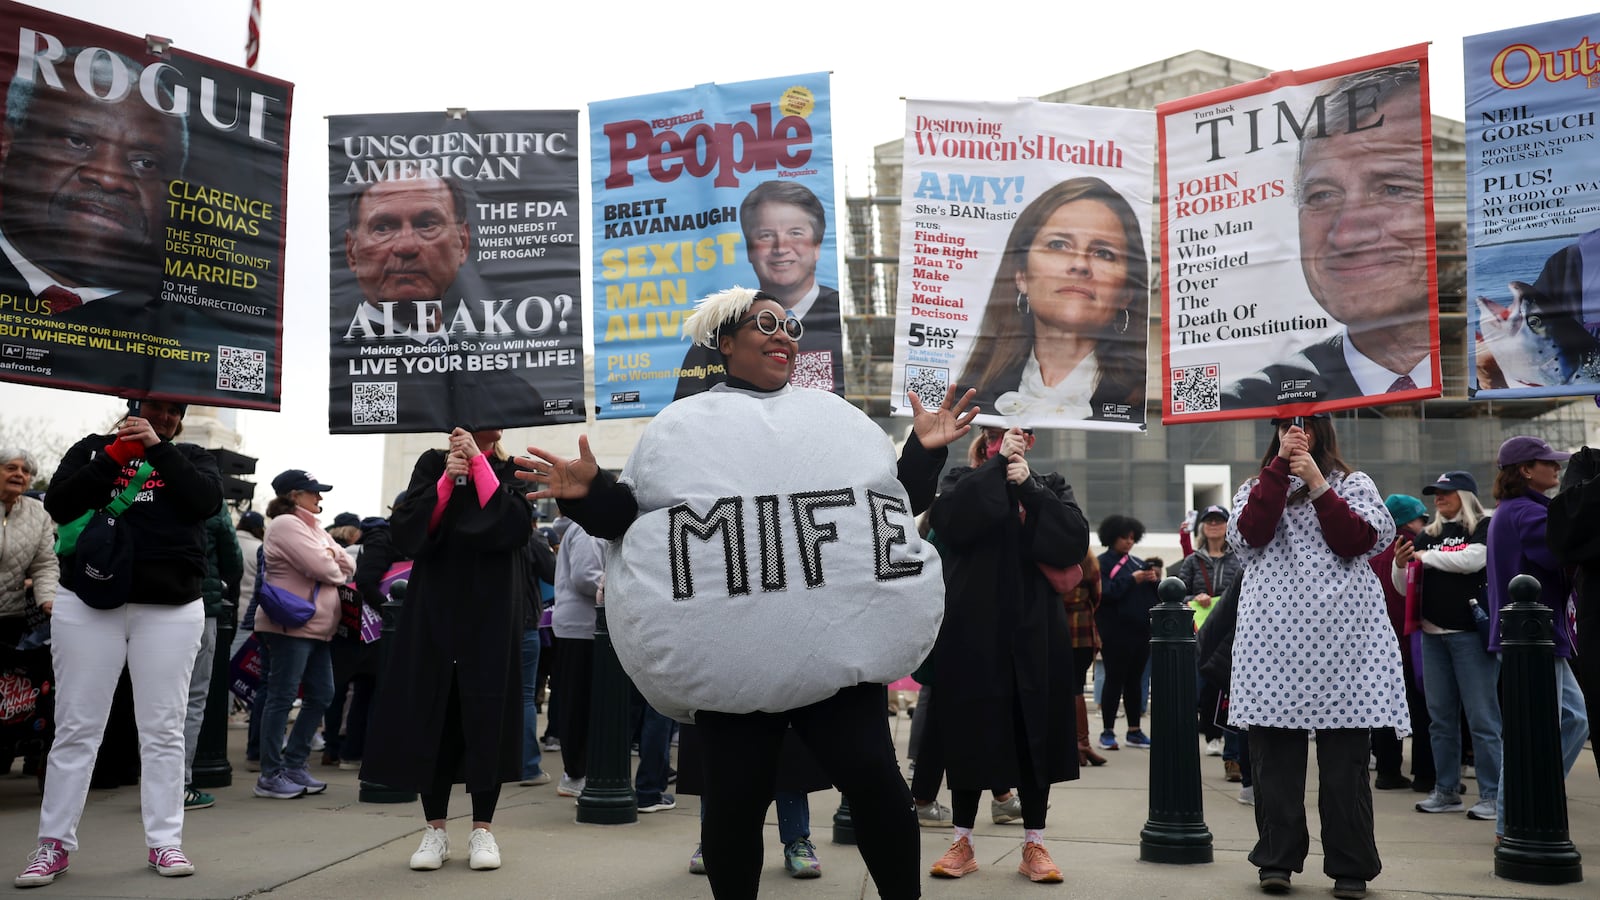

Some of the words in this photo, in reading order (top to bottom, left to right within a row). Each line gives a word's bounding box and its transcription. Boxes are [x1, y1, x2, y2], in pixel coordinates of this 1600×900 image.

[17, 27, 280, 145] ROGUE
[651, 109, 704, 131] regnant
[1194, 111, 1214, 120] Turn
[1215, 104, 1235, 115] back
[1195, 83, 1385, 163] TIME
[1481, 105, 1534, 125] NEIL
[916, 115, 1002, 140] Destroying
[1481, 112, 1595, 143] GORSUCH
[343, 132, 567, 159] UNSCIENTIFIC
[603, 102, 813, 190] People
[1482, 143, 1530, 158] PIONEER
[1534, 141, 1546, 149] IN
[1548, 133, 1595, 146] STOLEN
[1481, 152, 1526, 167] SCOTUS
[1528, 147, 1564, 159] SEATS
[343, 155, 521, 185] AMERICAN
[777, 168, 818, 178] Magazine
[1483, 168, 1552, 193] PLUS!
[913, 171, 1025, 205] AMY!
[1174, 171, 1239, 201] JOHN
[1483, 195, 1504, 207] MY
[1508, 189, 1548, 203] BODY
[1551, 185, 1572, 196] OF
[168, 180, 272, 220] CLARENCE
[604, 198, 667, 221] BRETT
[1175, 179, 1285, 219] ROBERTS
[1483, 207, 1504, 219] MY
[1508, 197, 1565, 215] CHOICE
[167, 200, 259, 236] THOMAS
[477, 203, 518, 220] THE
[524, 201, 568, 218] FDA
[915, 204, 946, 216] She's
[949, 203, 1017, 221] BANtastic
[1483, 219, 1499, 227] The
[1501, 215, 1538, 226] Supreme
[1540, 210, 1566, 218] Court
[478, 225, 506, 235] WHO
[509, 222, 544, 234] NEEDS
[547, 222, 557, 231] IT
[604, 206, 737, 239] KAVANAUGH
[915, 221, 941, 230] PLUS:
[1176, 227, 1209, 244] The
[1214, 220, 1253, 238] Man
[1483, 226, 1503, 236] They
[1506, 224, 1521, 232] Get
[1524, 220, 1549, 229] Away
[1551, 216, 1577, 225] With!
[166, 227, 190, 242] THE
[194, 232, 236, 250] STRICT
[478, 236, 513, 248] WHEN
[515, 234, 547, 246] WE'VE
[550, 233, 573, 243] GOT
[914, 230, 966, 247] Finding
[165, 240, 271, 270] DESTRUCTIONIST
[477, 250, 498, 262] JOE
[500, 247, 546, 260] ROGAN?
[601, 233, 741, 280] SEXIST
[913, 243, 939, 255] The
[942, 246, 978, 259] Right
[1177, 244, 1217, 260] Who
[164, 257, 257, 289] MARRIED
[913, 256, 943, 268] Man
[946, 259, 963, 270] To
[1176, 251, 1249, 277] Presided
[912, 268, 950, 281] Make
[1177, 277, 1219, 294] Over
[162, 280, 175, 291] TO
[177, 283, 198, 294] THE
[605, 279, 687, 310] MAN
[912, 281, 943, 293] Your
[0, 294, 52, 316] PLUS
[161, 291, 267, 316] GINNSURRECTIONIST
[911, 293, 964, 308] Medical
[1177, 295, 1209, 311] The
[343, 294, 573, 339] ALEAKO?
[911, 306, 968, 321] Decisons
[1177, 308, 1227, 329] Death
[1233, 303, 1258, 320] Of
[0, 314, 22, 324] HE'S
[23, 317, 66, 329] COMING
[67, 323, 88, 333] FOR
[89, 326, 111, 337] OUR
[112, 329, 140, 340] BIRTH
[141, 333, 181, 347] CONTROL
[908, 322, 925, 347] 5
[926, 326, 959, 339] EASY
[1178, 330, 1211, 345] The
[1216, 315, 1328, 340] Constitution
[0, 324, 29, 338] BUT
[31, 328, 87, 347] WHERE
[88, 336, 124, 351] WILL
[126, 341, 146, 354] HE
[147, 345, 189, 360] STORE
[191, 351, 210, 363] IT?
[360, 345, 402, 357] Making
[404, 341, 459, 355] Decisions
[461, 340, 476, 351] So
[478, 341, 501, 351] You
[503, 339, 524, 350] Will
[526, 338, 560, 349] Never
[926, 338, 954, 350] TIPS
[0, 362, 52, 375] aafront.org
[349, 358, 397, 376] LIVE
[400, 355, 462, 374] YOUR
[467, 352, 521, 372] BEST
[525, 349, 576, 369] LIFE!
[608, 353, 651, 370] PLUS
[608, 371, 627, 382] Are
[673, 366, 706, 379] Really
[1277, 391, 1317, 401] aafront.org
[668, 487, 924, 601] MIFE
